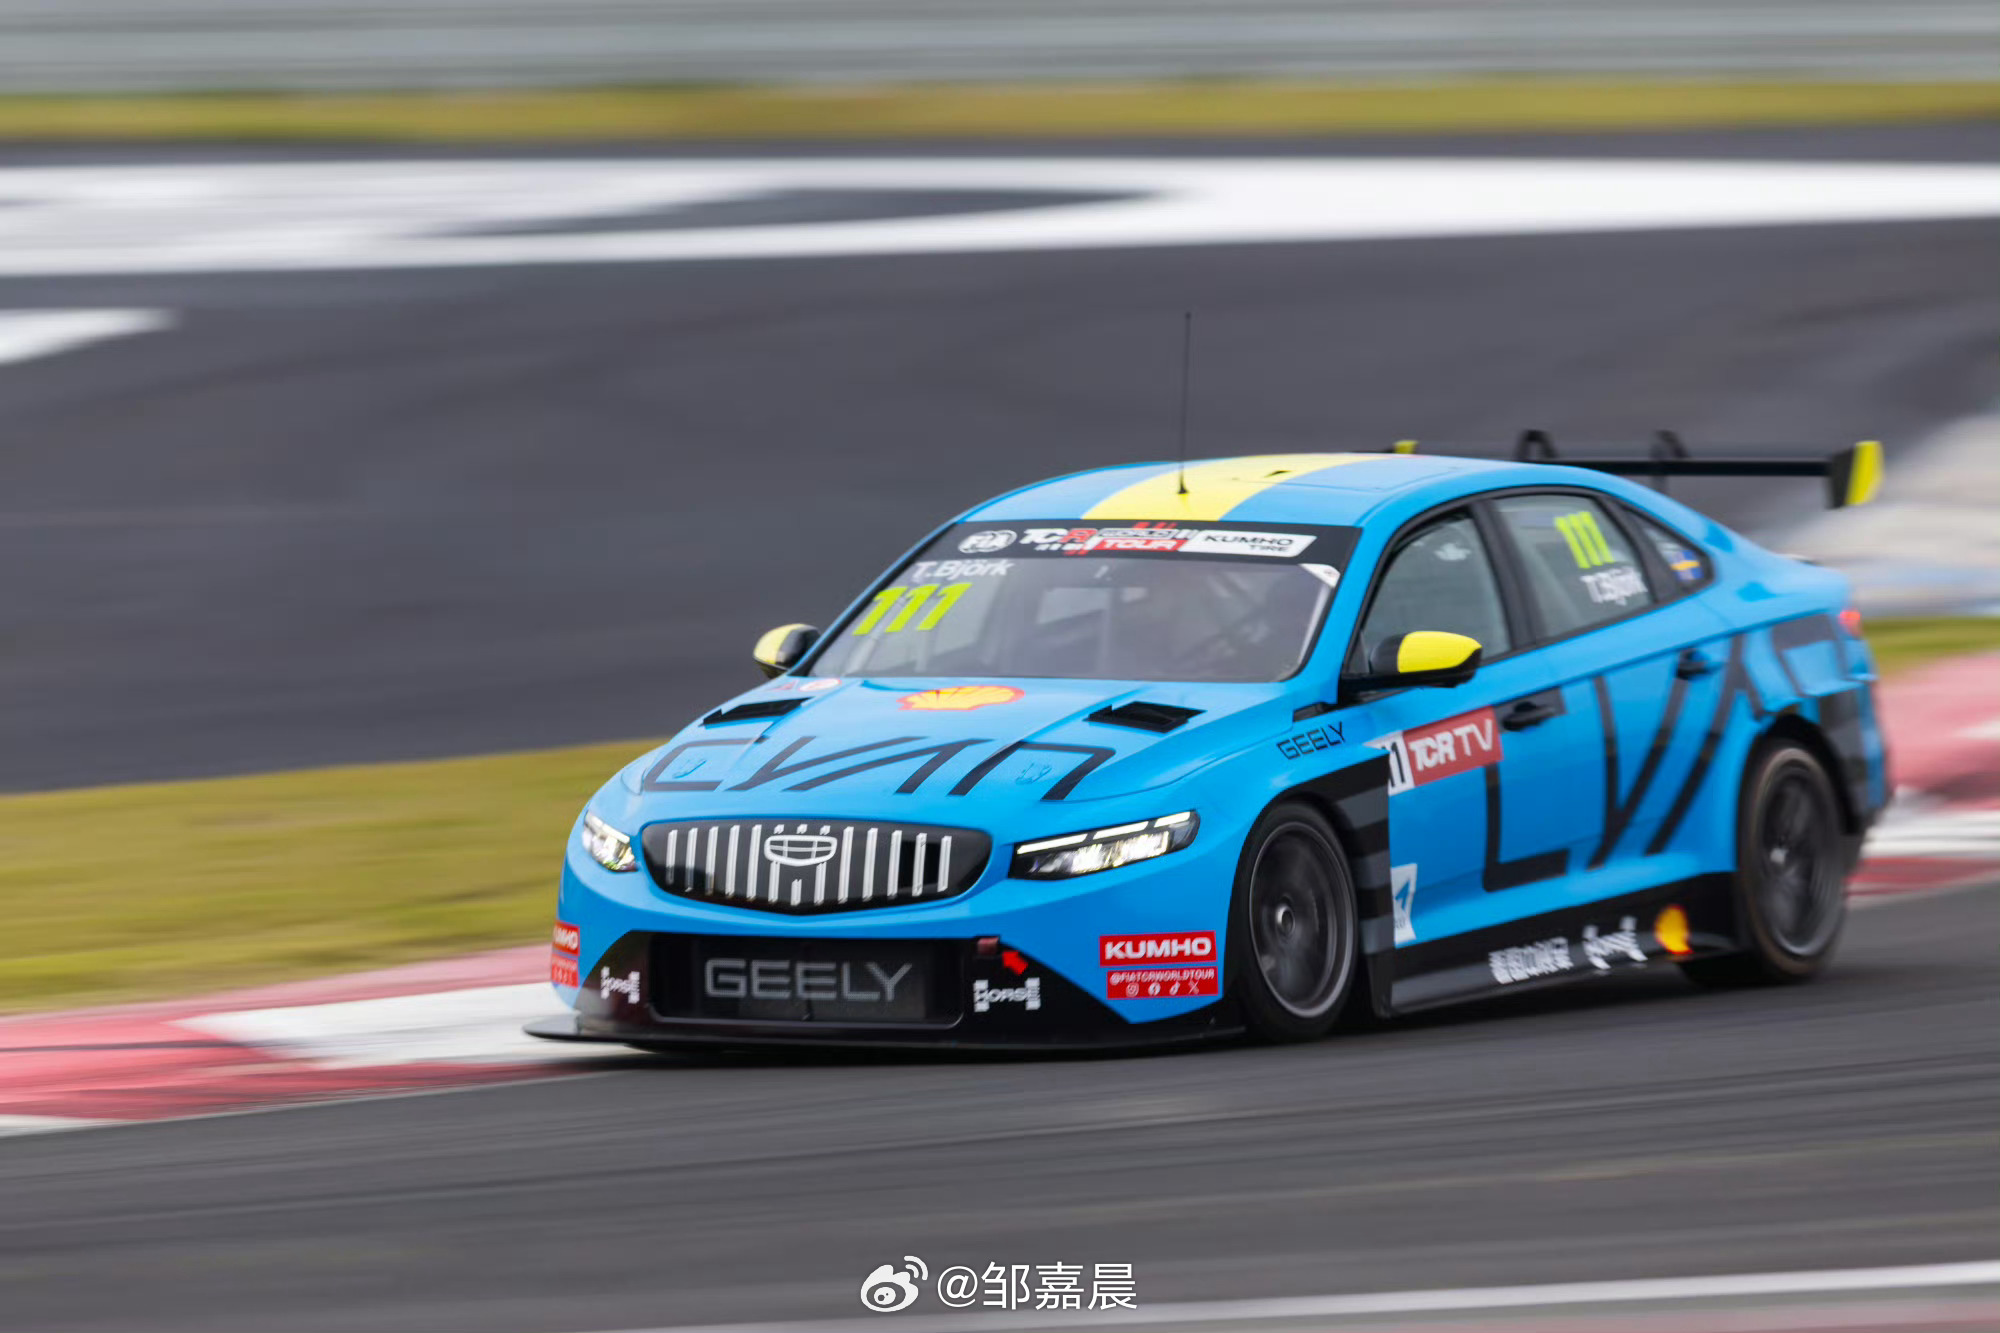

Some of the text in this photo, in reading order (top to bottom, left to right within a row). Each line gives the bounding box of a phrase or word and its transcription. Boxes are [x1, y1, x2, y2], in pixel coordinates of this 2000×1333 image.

[1104, 539, 1177, 549] TOUR
[1204, 535, 1294, 546] KUMHO
[1554, 511, 1615, 568] 111
[911, 559, 1014, 580] T.Björk
[852, 582, 973, 635] 111
[1276, 721, 1346, 761] GEELY
[1408, 719, 1493, 771] TCR TV
[1105, 937, 1212, 960] KUMHO
[705, 957, 913, 1001] GEELY
[1110, 969, 1215, 986] @FIATCRWORLDTOUR
